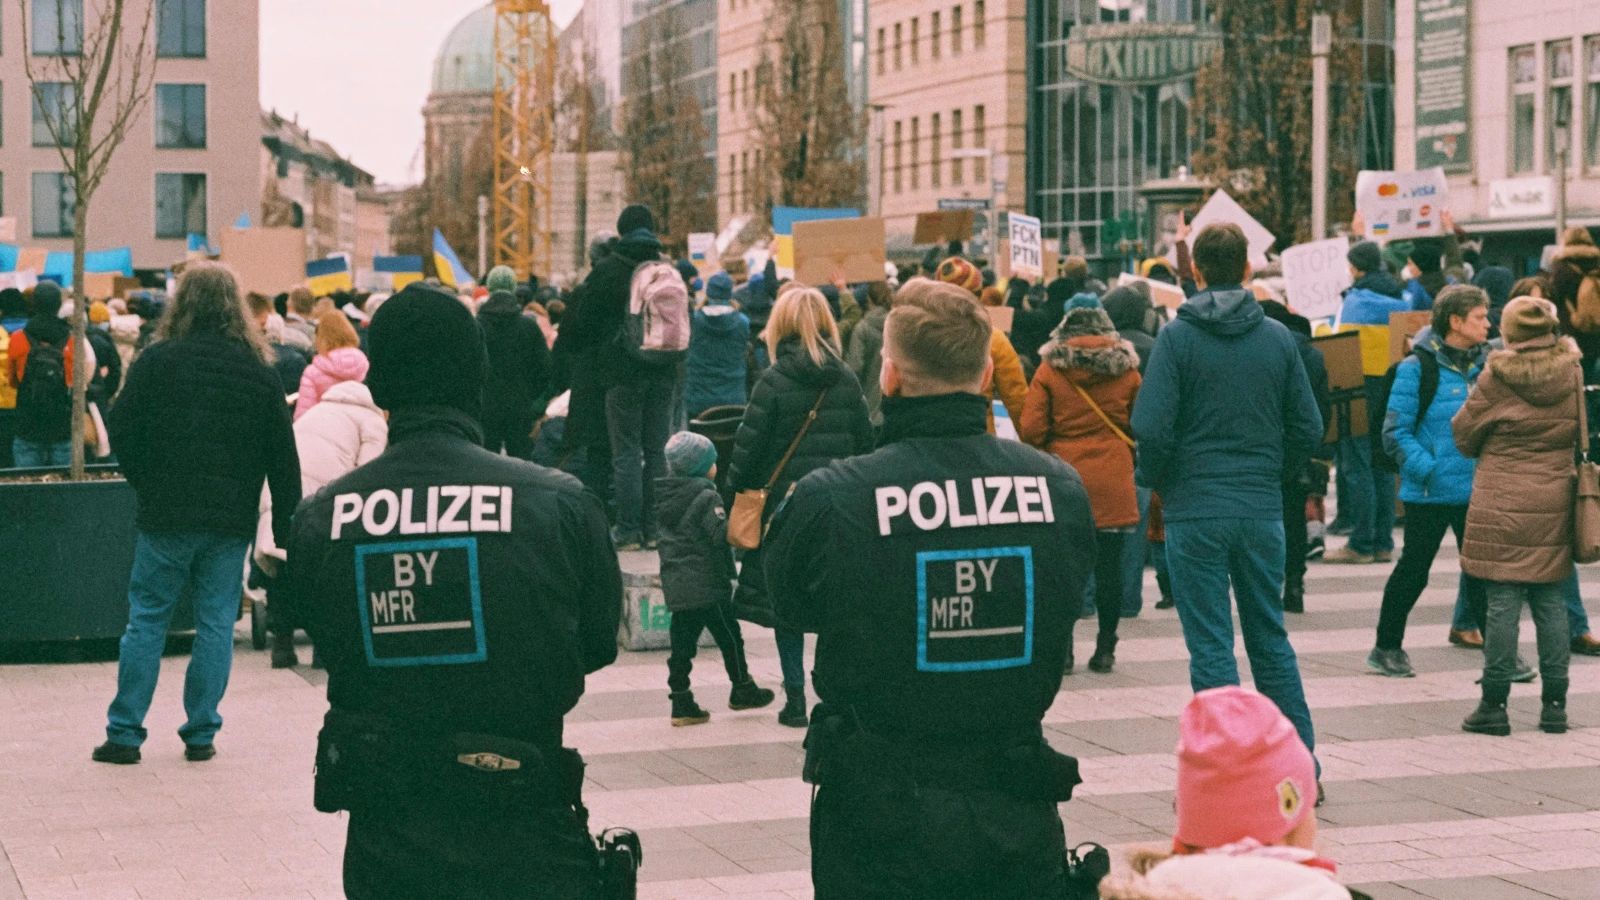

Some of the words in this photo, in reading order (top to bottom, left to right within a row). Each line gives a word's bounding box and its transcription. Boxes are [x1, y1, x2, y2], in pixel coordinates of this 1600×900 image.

[1411, 185, 1436, 198] VISA
[1012, 223, 1039, 246] FCK
[1012, 244, 1039, 267] PTN
[1287, 244, 1340, 280] STOP
[331, 485, 512, 540] POLIZEI
[875, 476, 1055, 536] POLIZEI
[393, 551, 439, 587] BY
[955, 558, 998, 594] BY
[371, 590, 416, 624] MFR
[931, 596, 973, 628] MFR
